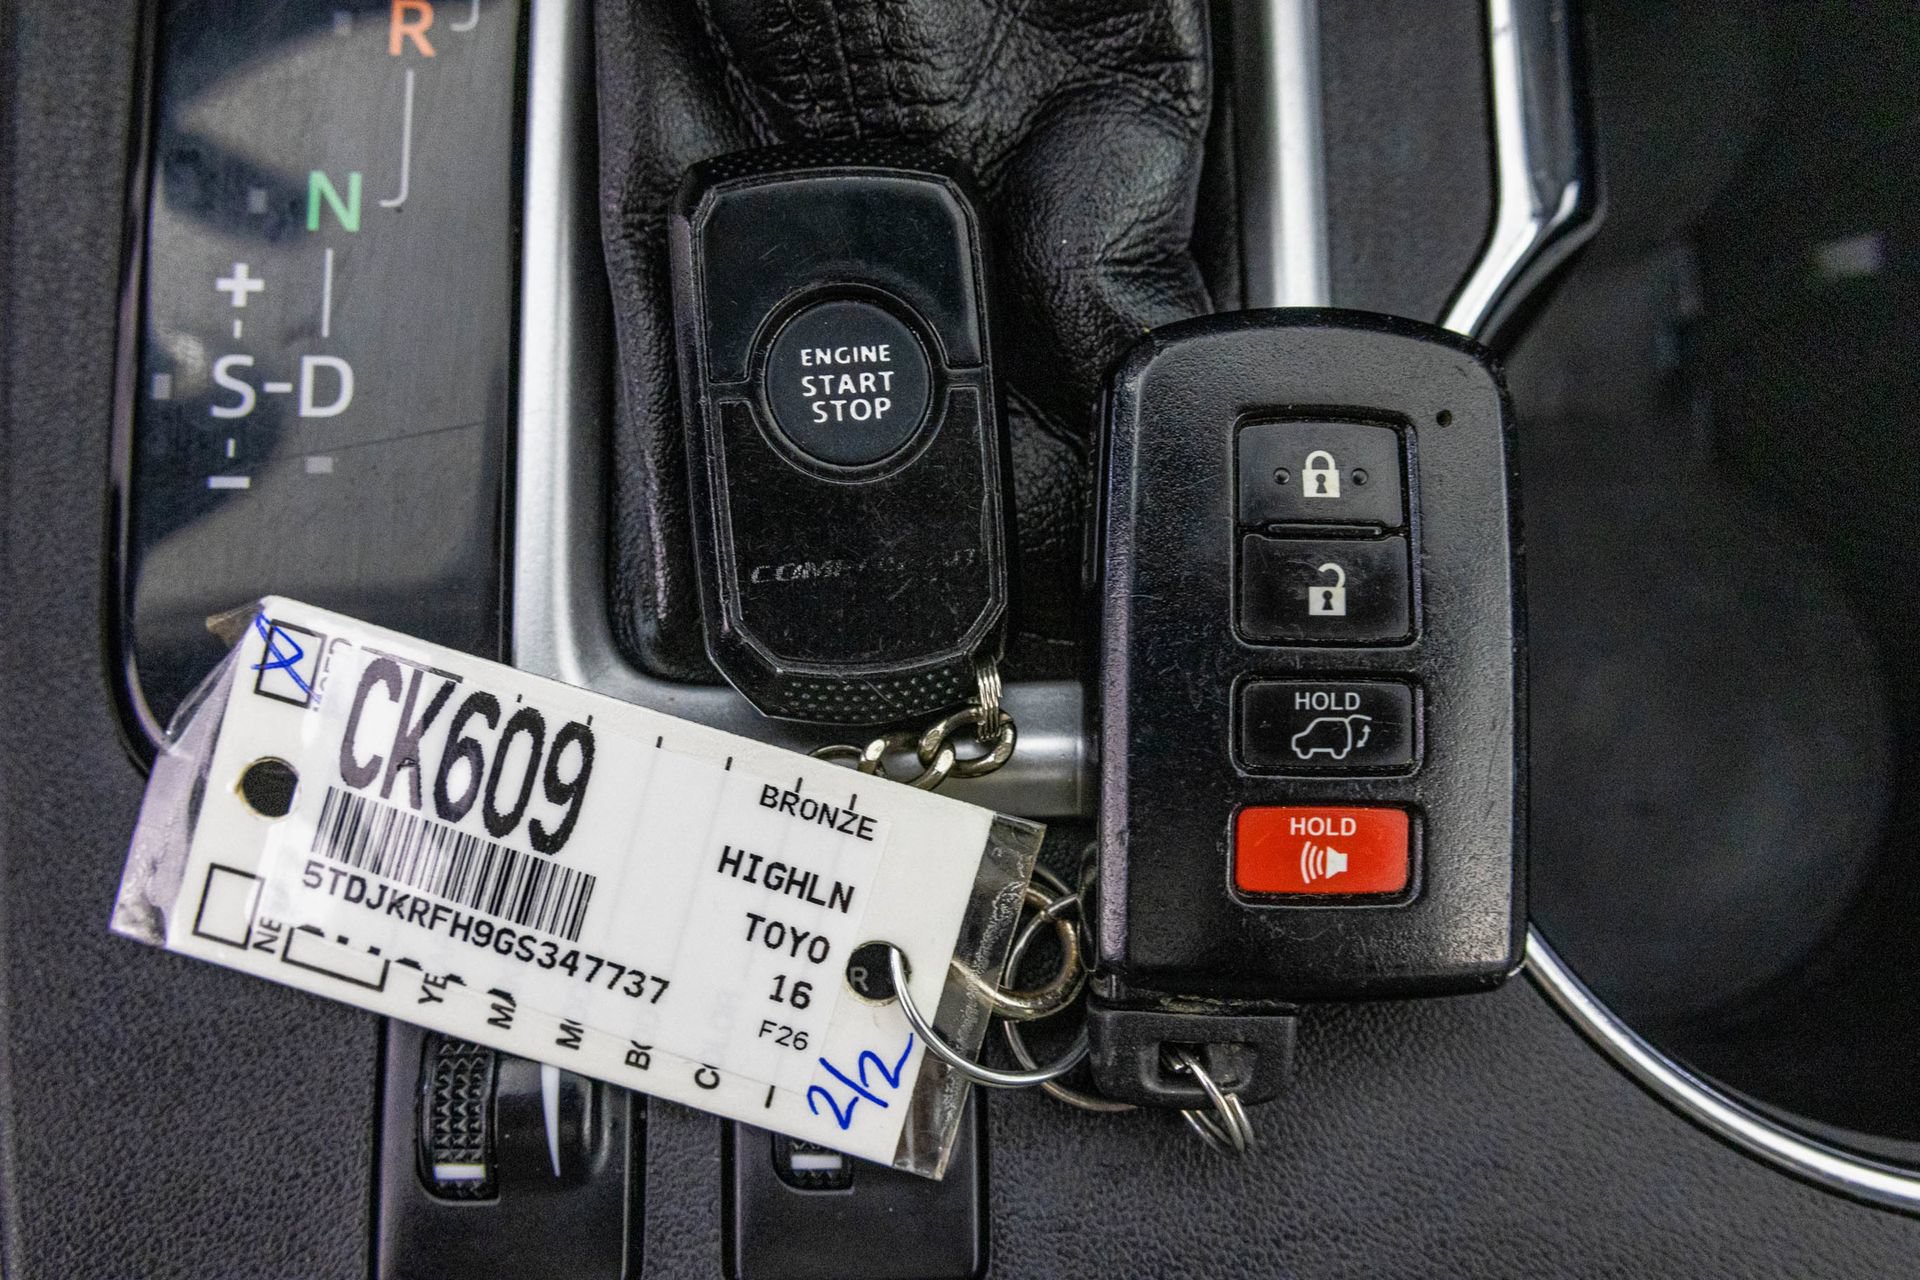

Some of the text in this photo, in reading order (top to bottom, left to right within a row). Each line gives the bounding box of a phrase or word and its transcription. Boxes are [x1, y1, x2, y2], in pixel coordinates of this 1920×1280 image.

[388, 0, 436, 57] R
[306, 170, 362, 232] N
[800, 344, 891, 366] ENGINE
[211, 354, 354, 418] S D
[801, 370, 894, 397] START
[812, 397, 891, 424] STOP
[1294, 691, 1361, 711] HOLD
[339, 657, 596, 856] CK609
[759, 783, 878, 842] BRONZE
[1289, 817, 1357, 836] HOLD
[716, 844, 855, 914] HIGHLN
[251, 916, 283, 954] NE
[302, 860, 670, 1004] 5TDJKRFH9GS347737
[744, 912, 832, 964] TOYO
[768, 973, 813, 1010] 16
[757, 1019, 810, 1051] F26
[806, 1032, 915, 1130] 2/2
